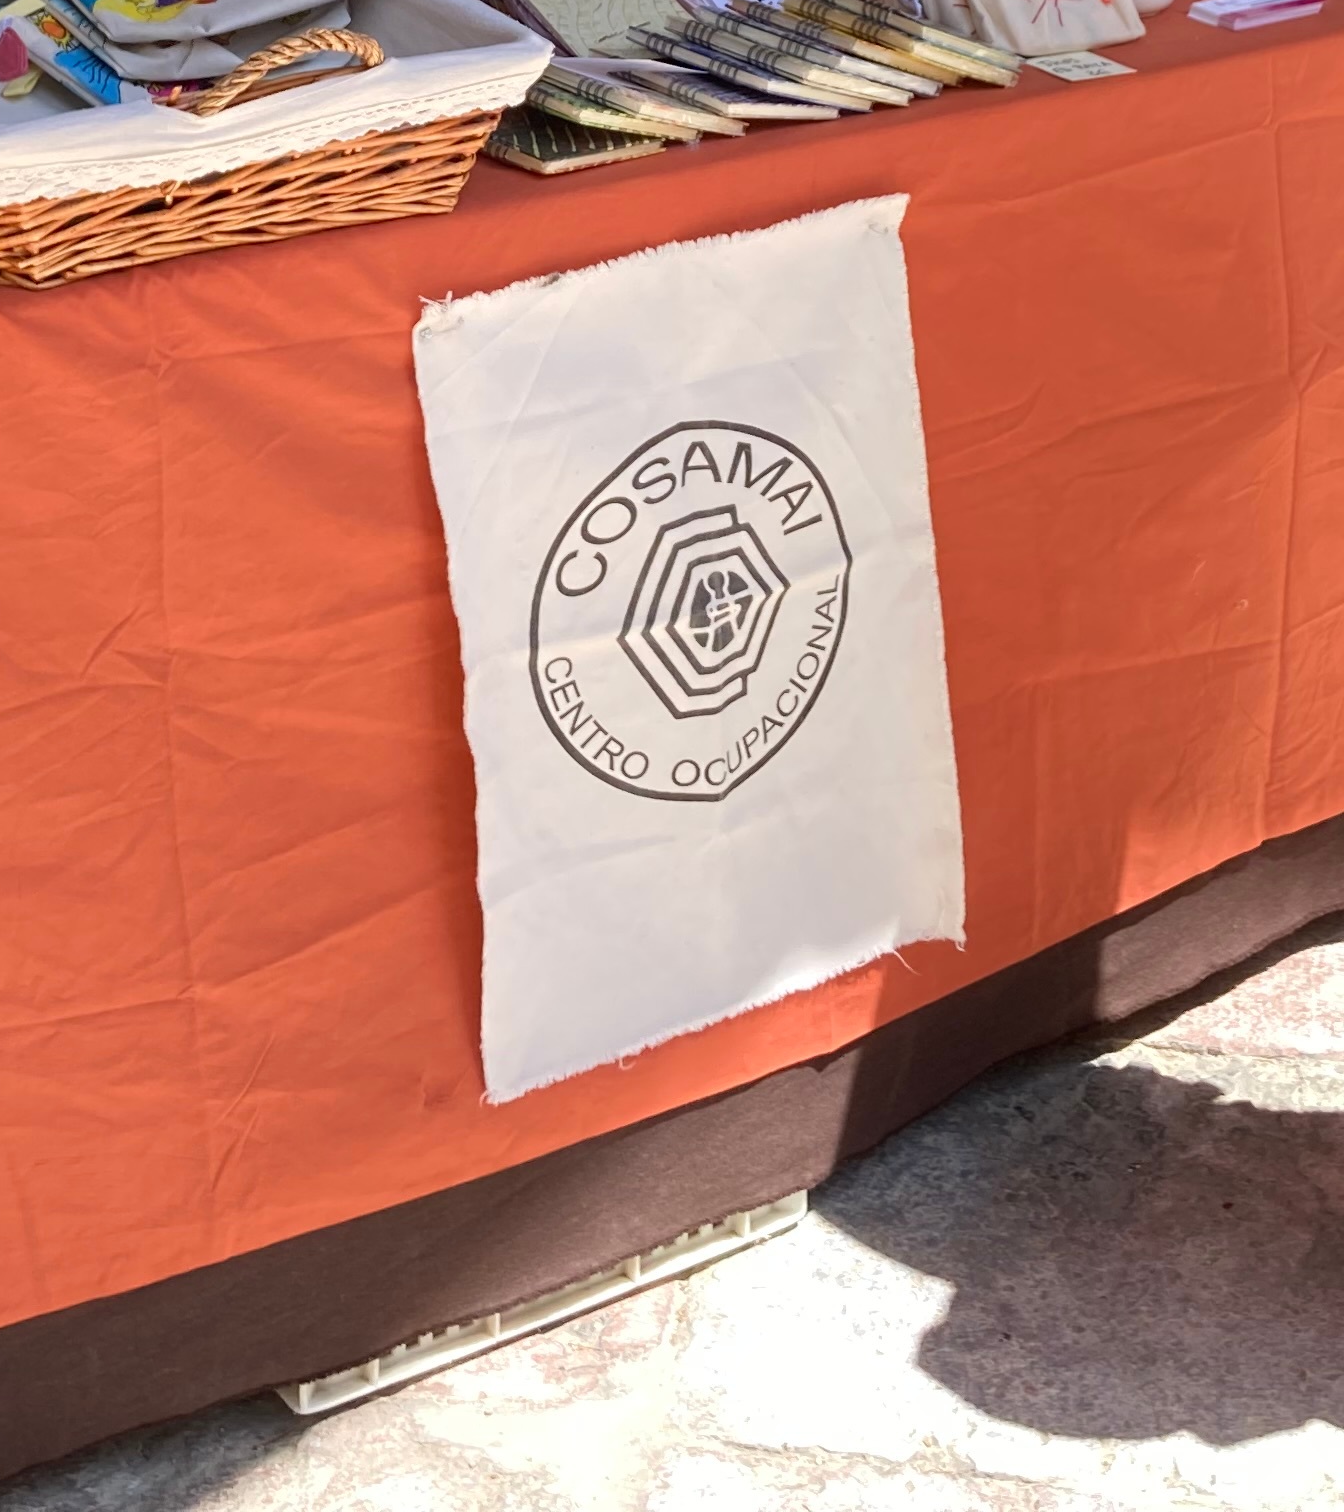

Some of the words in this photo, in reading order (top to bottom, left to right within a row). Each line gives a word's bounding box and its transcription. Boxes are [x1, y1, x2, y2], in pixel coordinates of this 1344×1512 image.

[555, 440, 823, 598] COSAMAI
[543, 655, 649, 781] CENTRO
[671, 572, 842, 789] OCUPACIONAL
